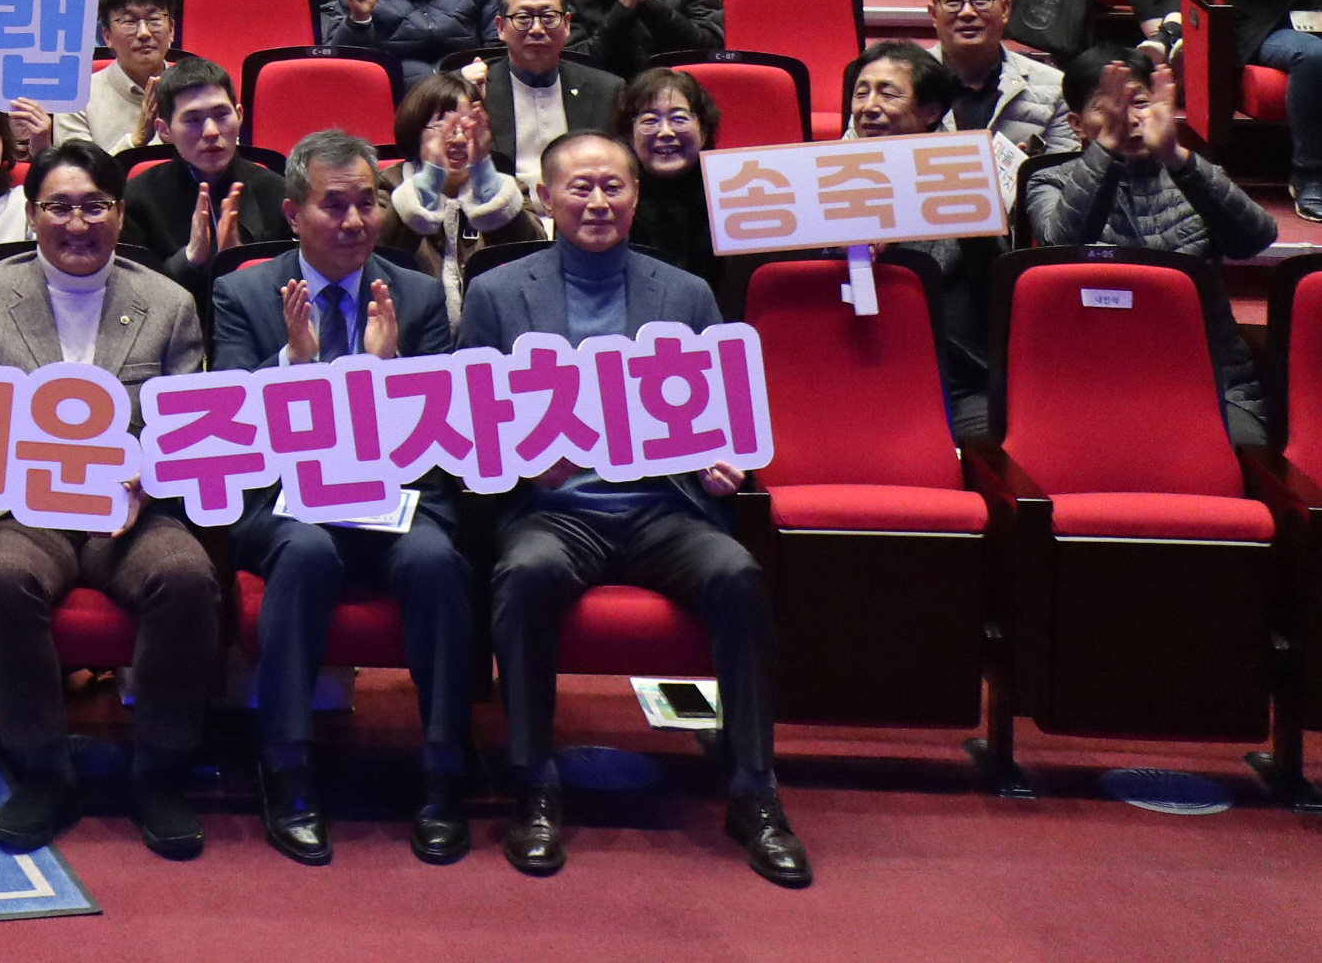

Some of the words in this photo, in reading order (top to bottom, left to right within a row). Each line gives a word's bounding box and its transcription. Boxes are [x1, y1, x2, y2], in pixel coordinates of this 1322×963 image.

[718, 145, 991, 240] 송죽동
[1088, 250, 1114, 258] A-05
[156, 338, 758, 510] 주민자치회
